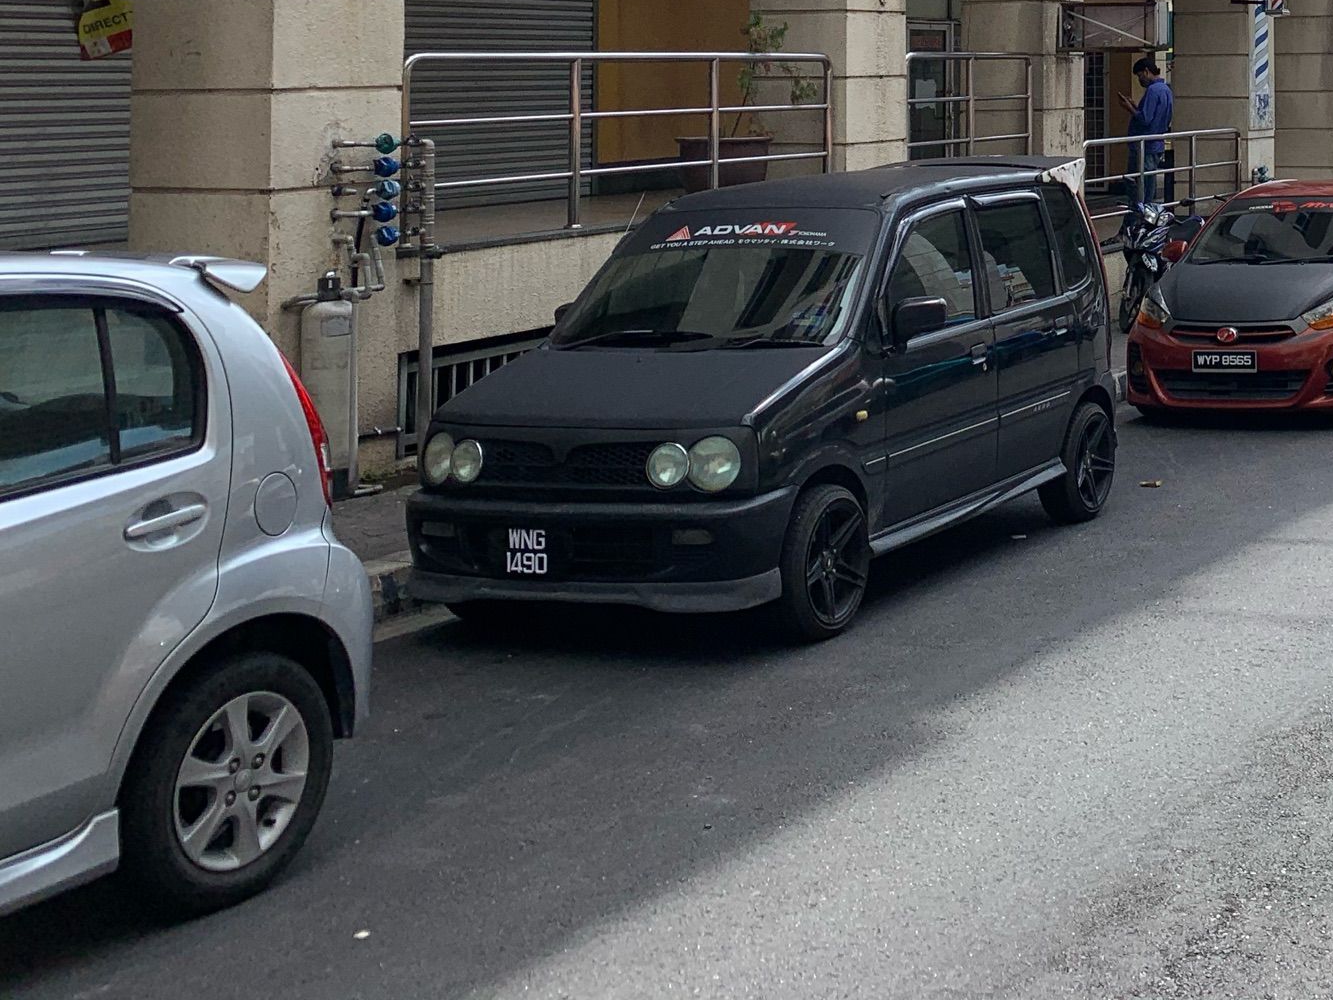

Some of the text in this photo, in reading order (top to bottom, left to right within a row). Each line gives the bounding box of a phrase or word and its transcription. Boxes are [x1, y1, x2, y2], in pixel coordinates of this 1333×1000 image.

[82, 11, 128, 35] DIRECT
[694, 224, 787, 237] ADVAN
[1197, 354, 1252, 366] WYP 8565
[508, 529, 546, 550] WNG
[506, 551, 548, 574] 1490
